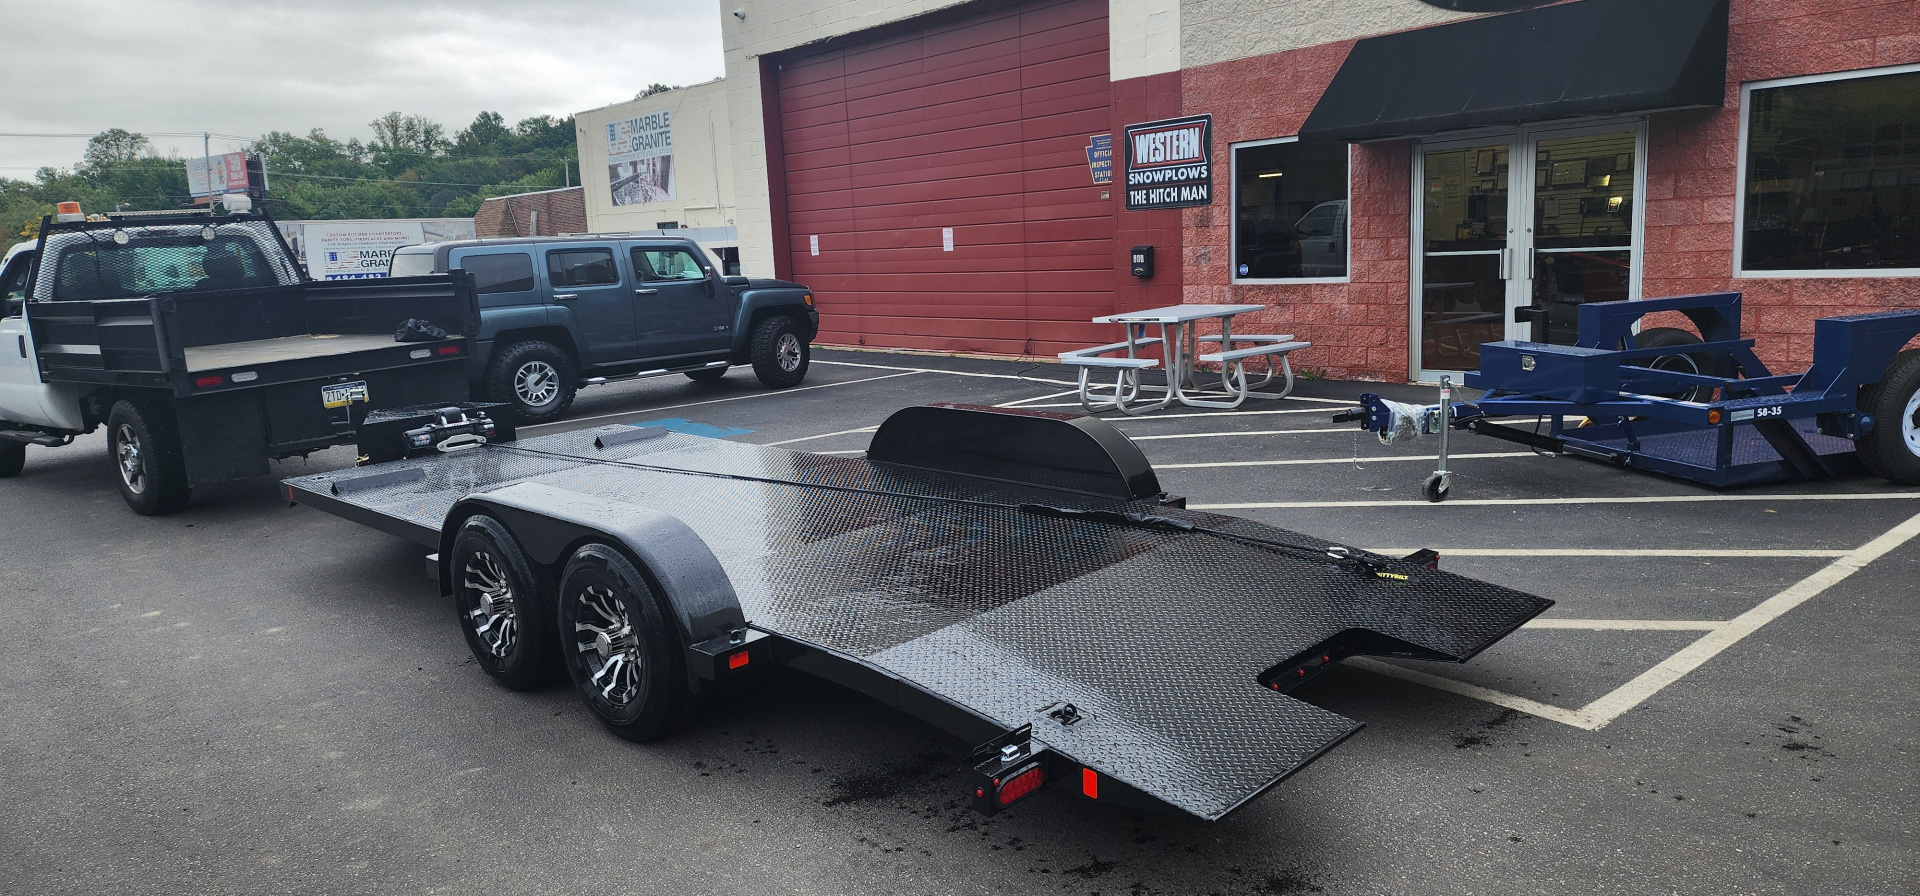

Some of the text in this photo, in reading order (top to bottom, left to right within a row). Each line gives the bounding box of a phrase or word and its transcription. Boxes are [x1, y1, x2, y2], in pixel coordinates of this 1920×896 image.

[630, 112, 670, 134] MARBLE
[631, 130, 672, 152] GRANITE
[1135, 127, 1200, 165] WESTERN
[1128, 166, 1208, 184] SNOWPLOWS
[1130, 184, 1208, 205] THE HITCH MAN
[1756, 406, 1782, 417] S8-35
